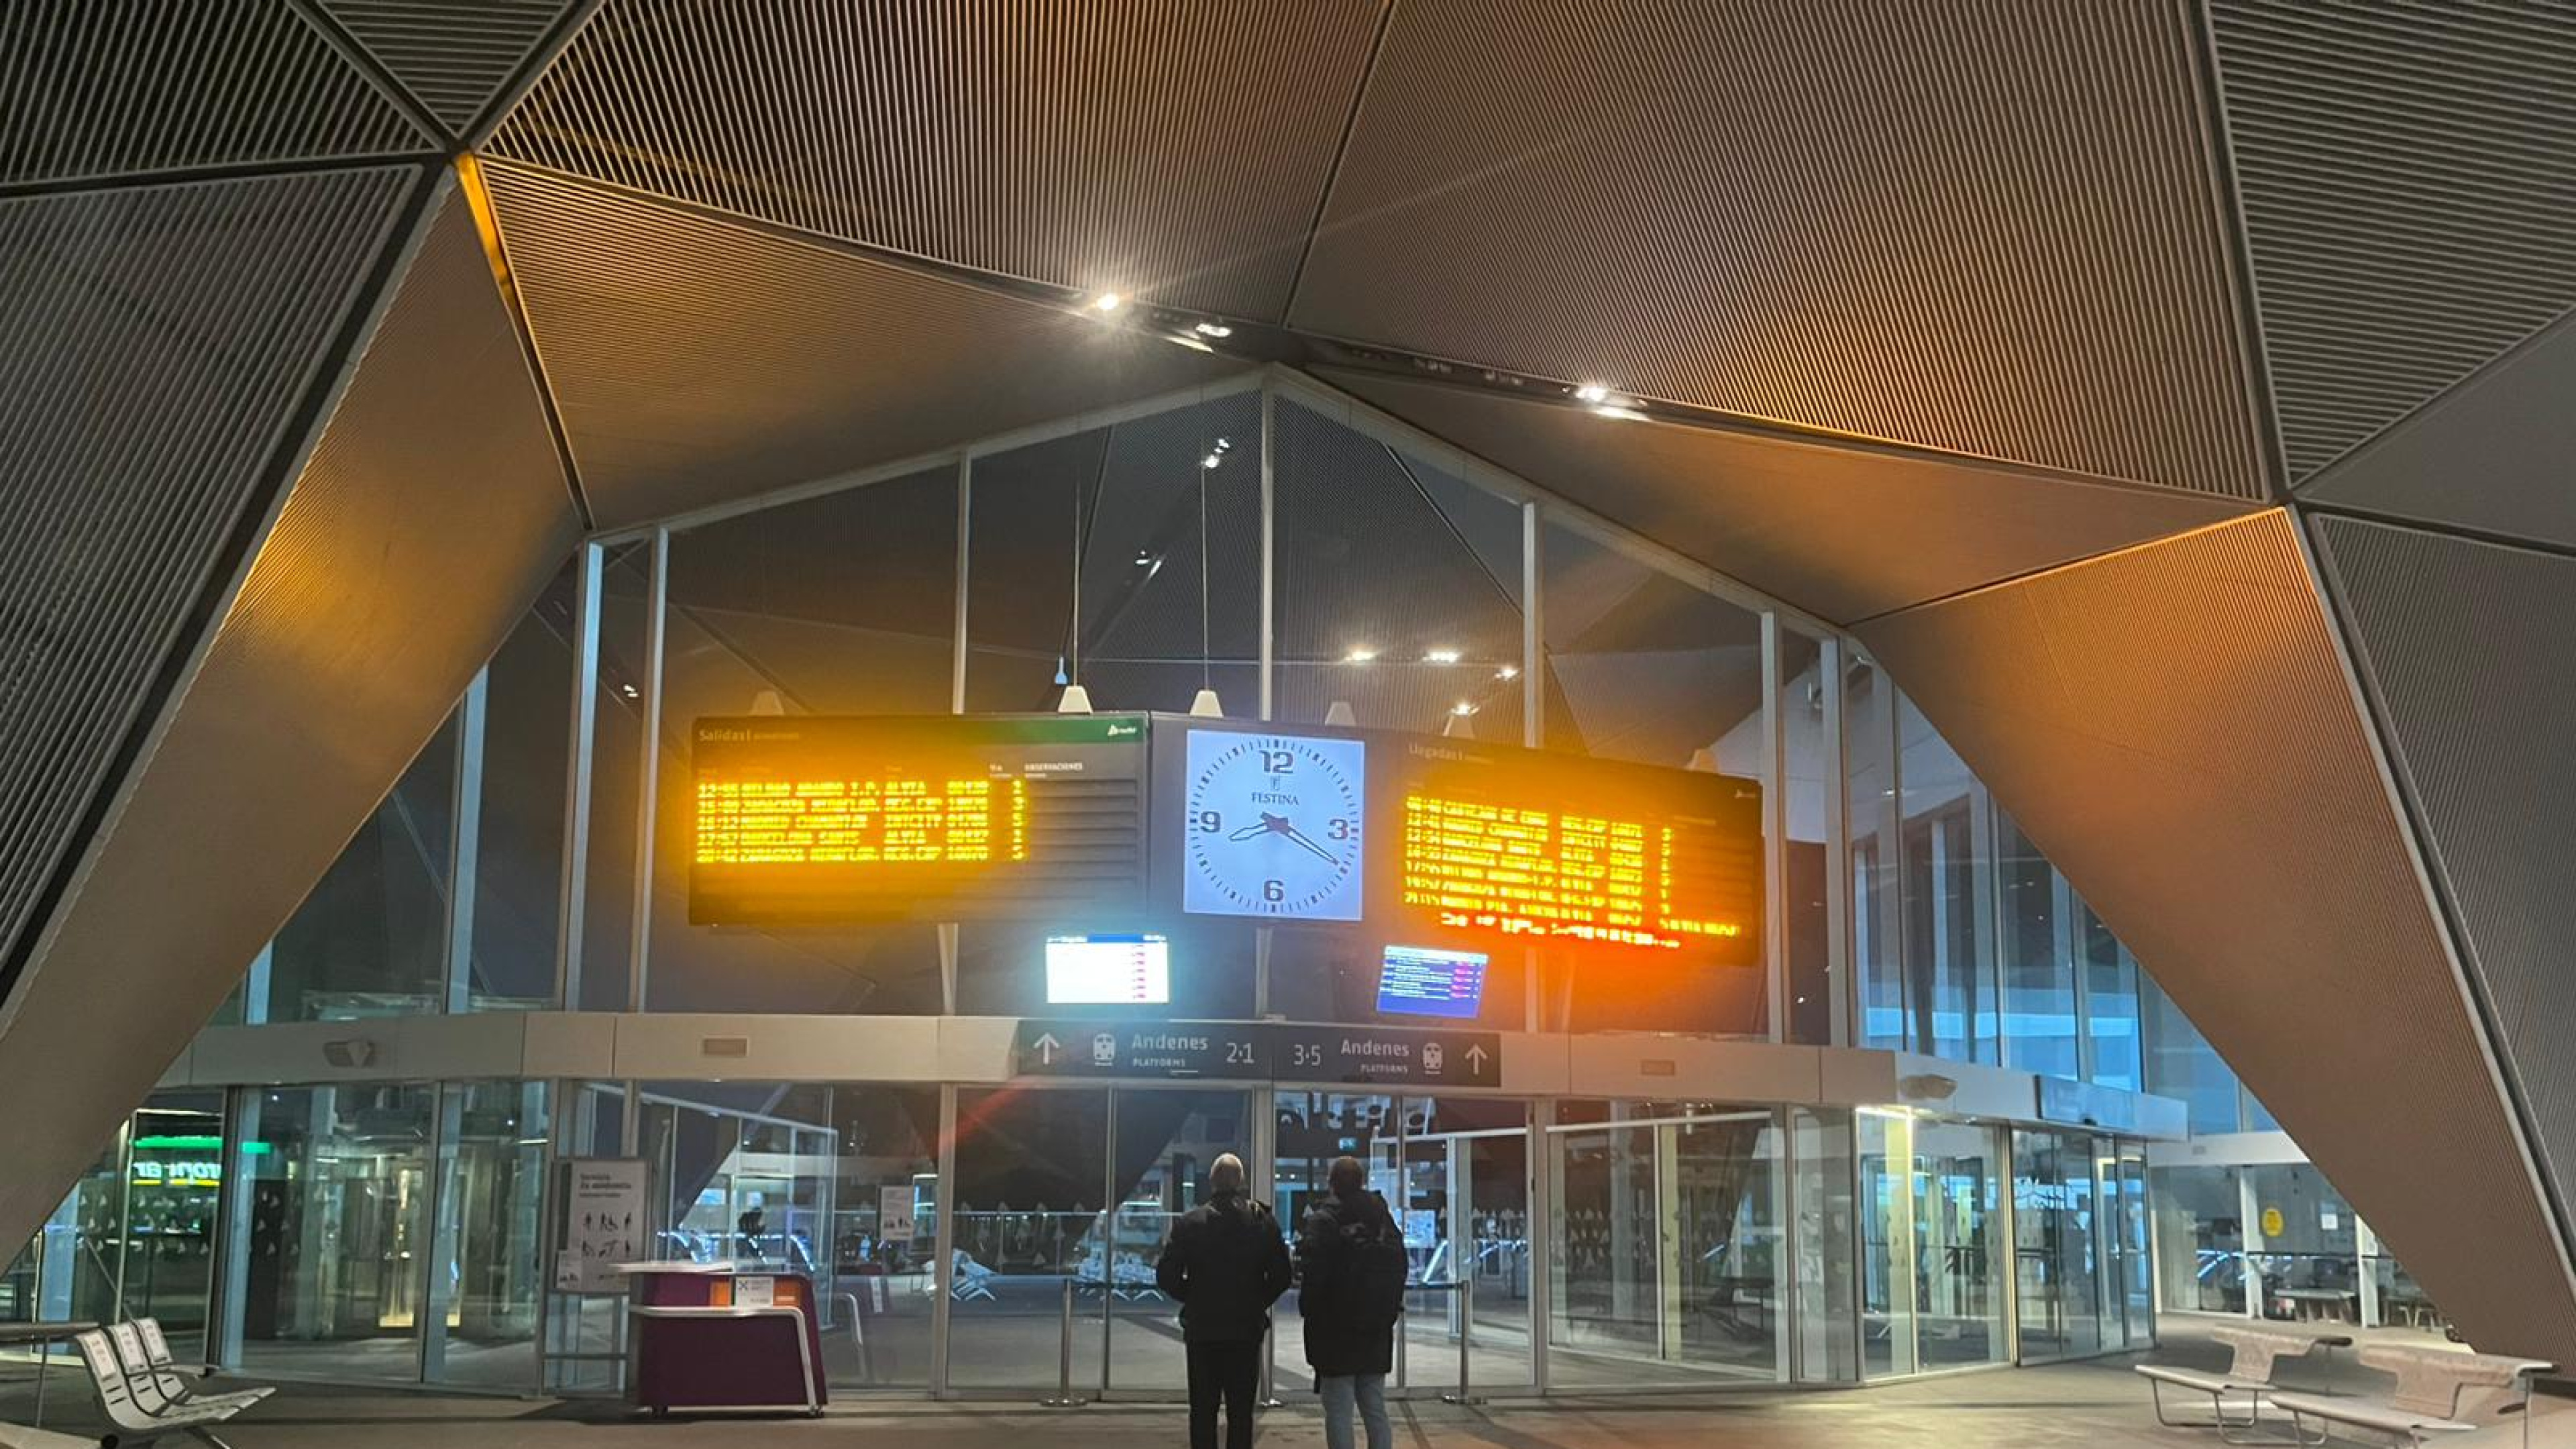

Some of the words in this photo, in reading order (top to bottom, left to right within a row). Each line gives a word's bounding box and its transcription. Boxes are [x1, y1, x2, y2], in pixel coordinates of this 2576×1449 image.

[1259, 750, 1293, 773] 12
[1251, 792, 1299, 806] FESTINA
[1200, 810, 1221, 833] 9
[1328, 818, 1348, 840] 3
[1263, 880, 1285, 902] 6
[1132, 1033, 1209, 1051] Andenes
[1340, 1038, 1410, 1057] Andenes
